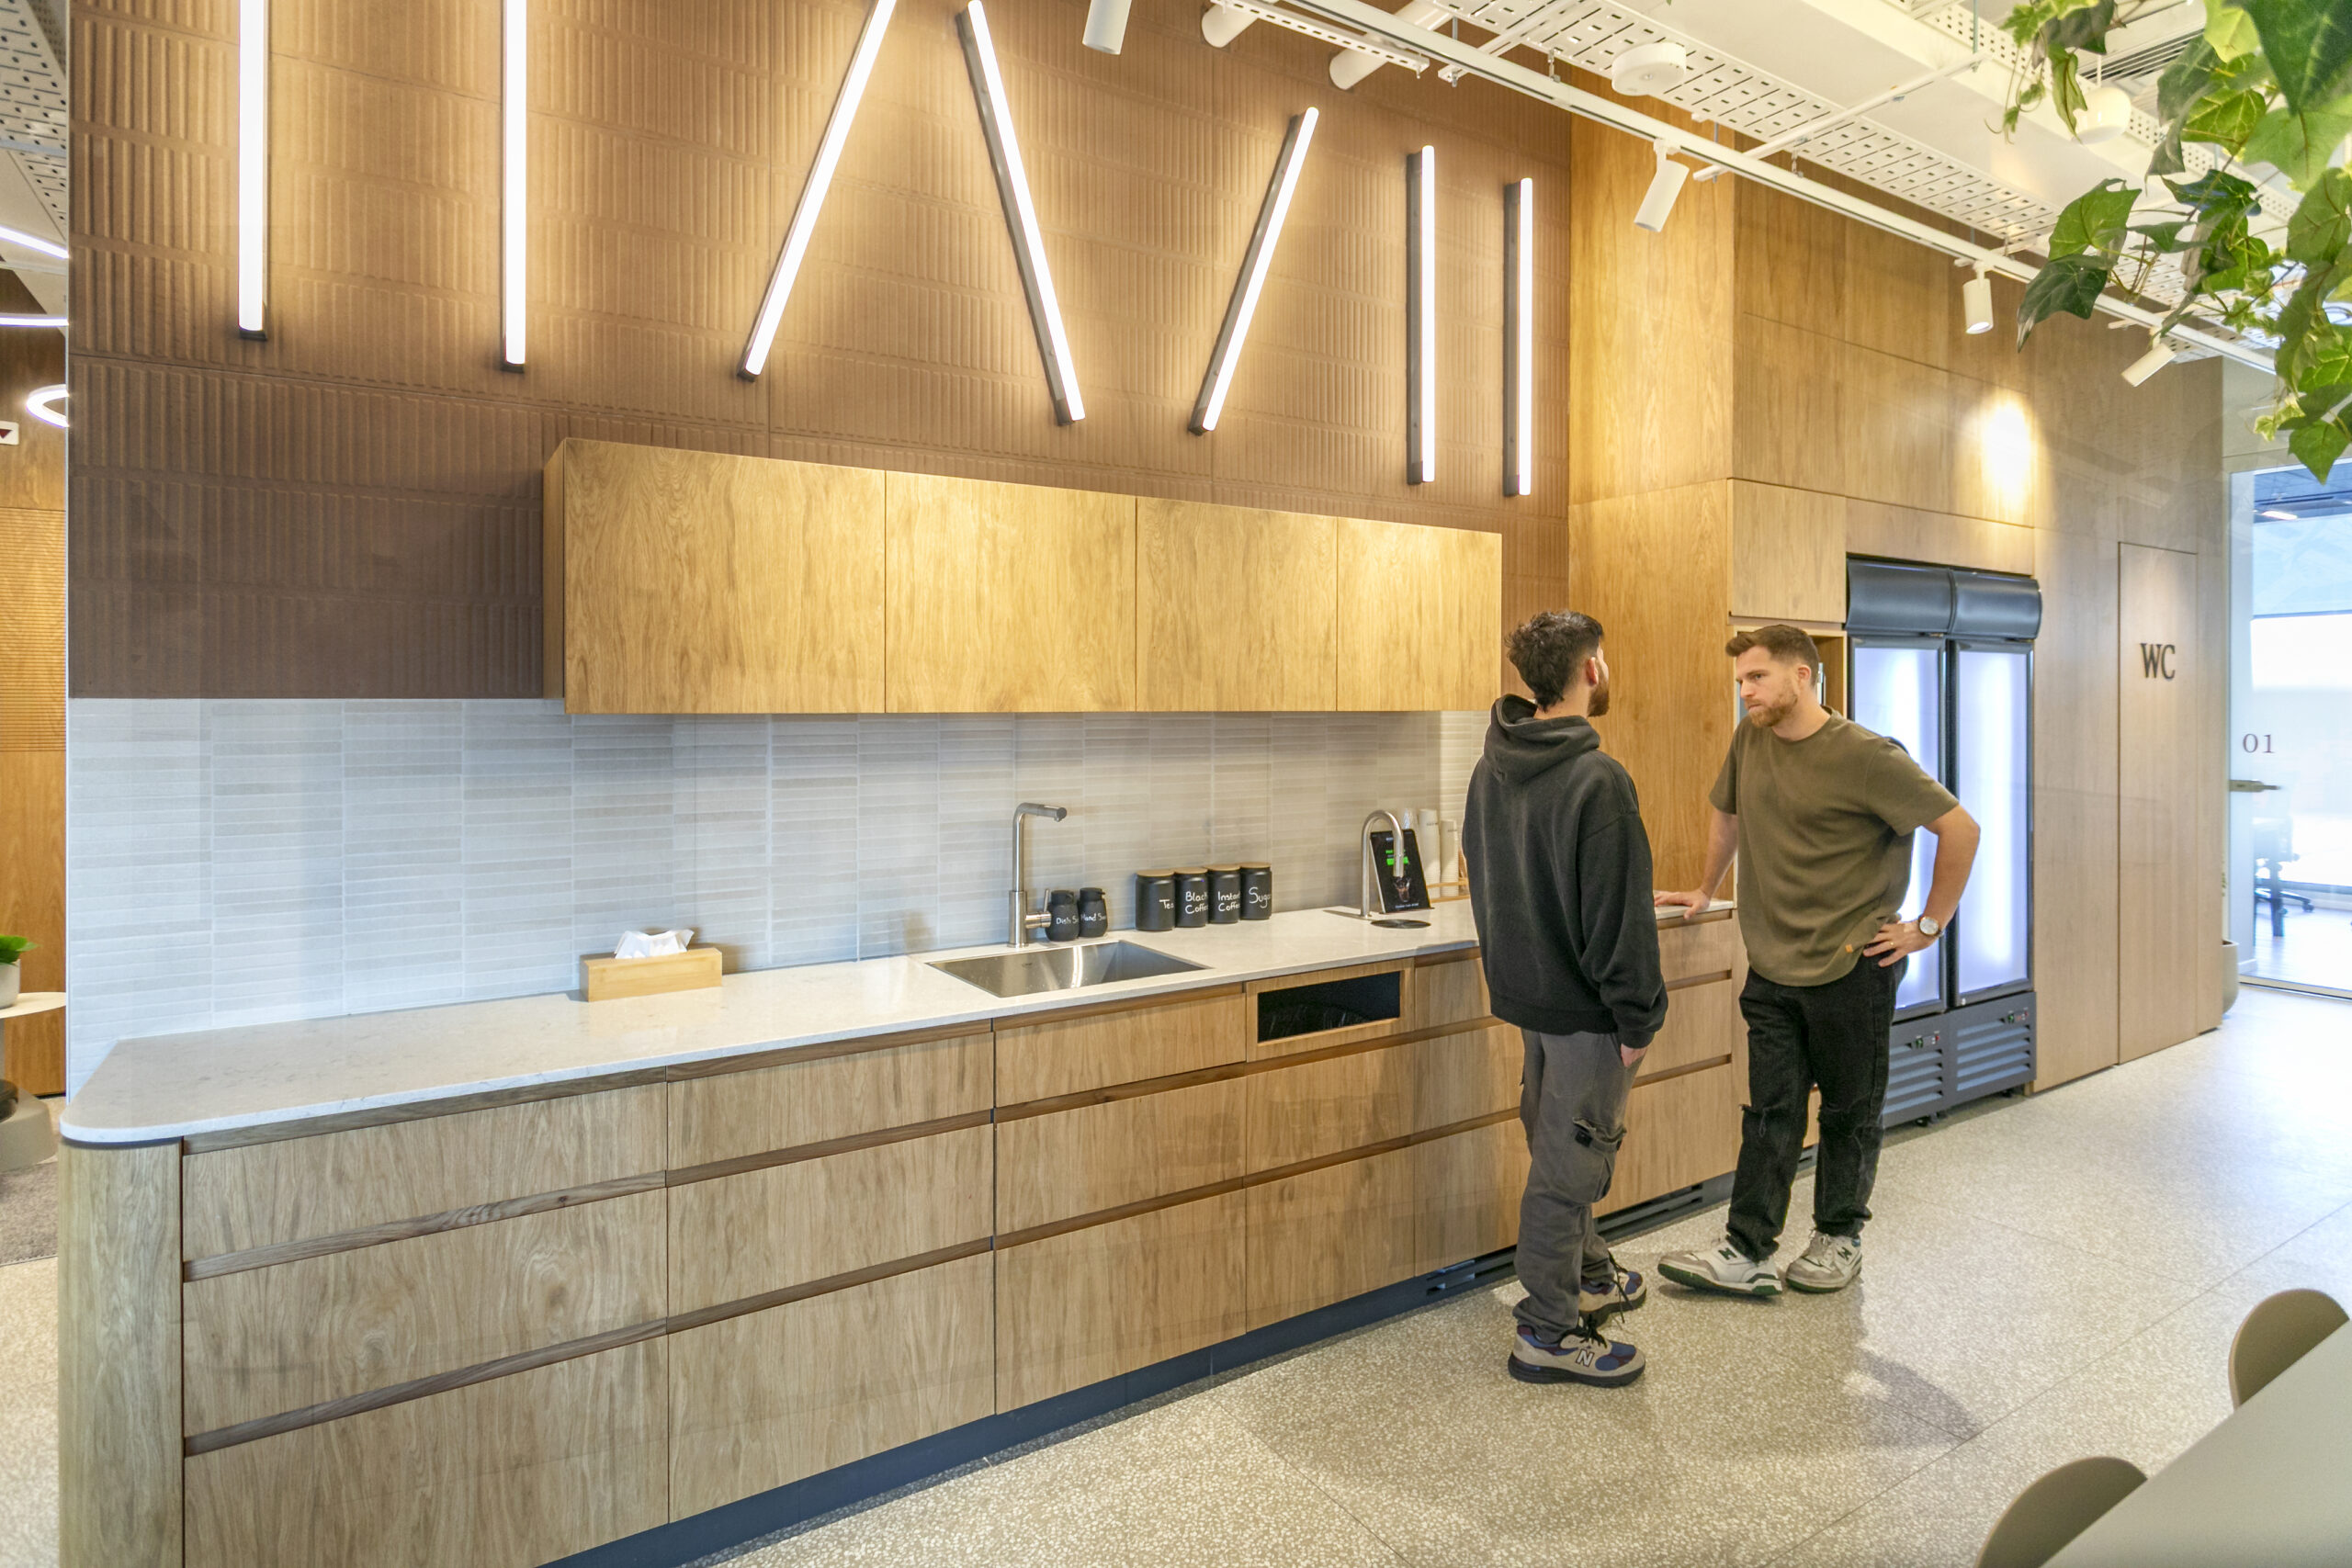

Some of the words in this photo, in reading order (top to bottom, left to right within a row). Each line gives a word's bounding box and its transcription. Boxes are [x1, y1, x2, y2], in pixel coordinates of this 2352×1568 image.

[2140, 642, 2176, 681] WC
[2242, 733, 2275, 754] 01
[1159, 898, 1174, 909] Tea
[1080, 912, 1097, 922] Hand
[1575, 1348, 1595, 1368] N
